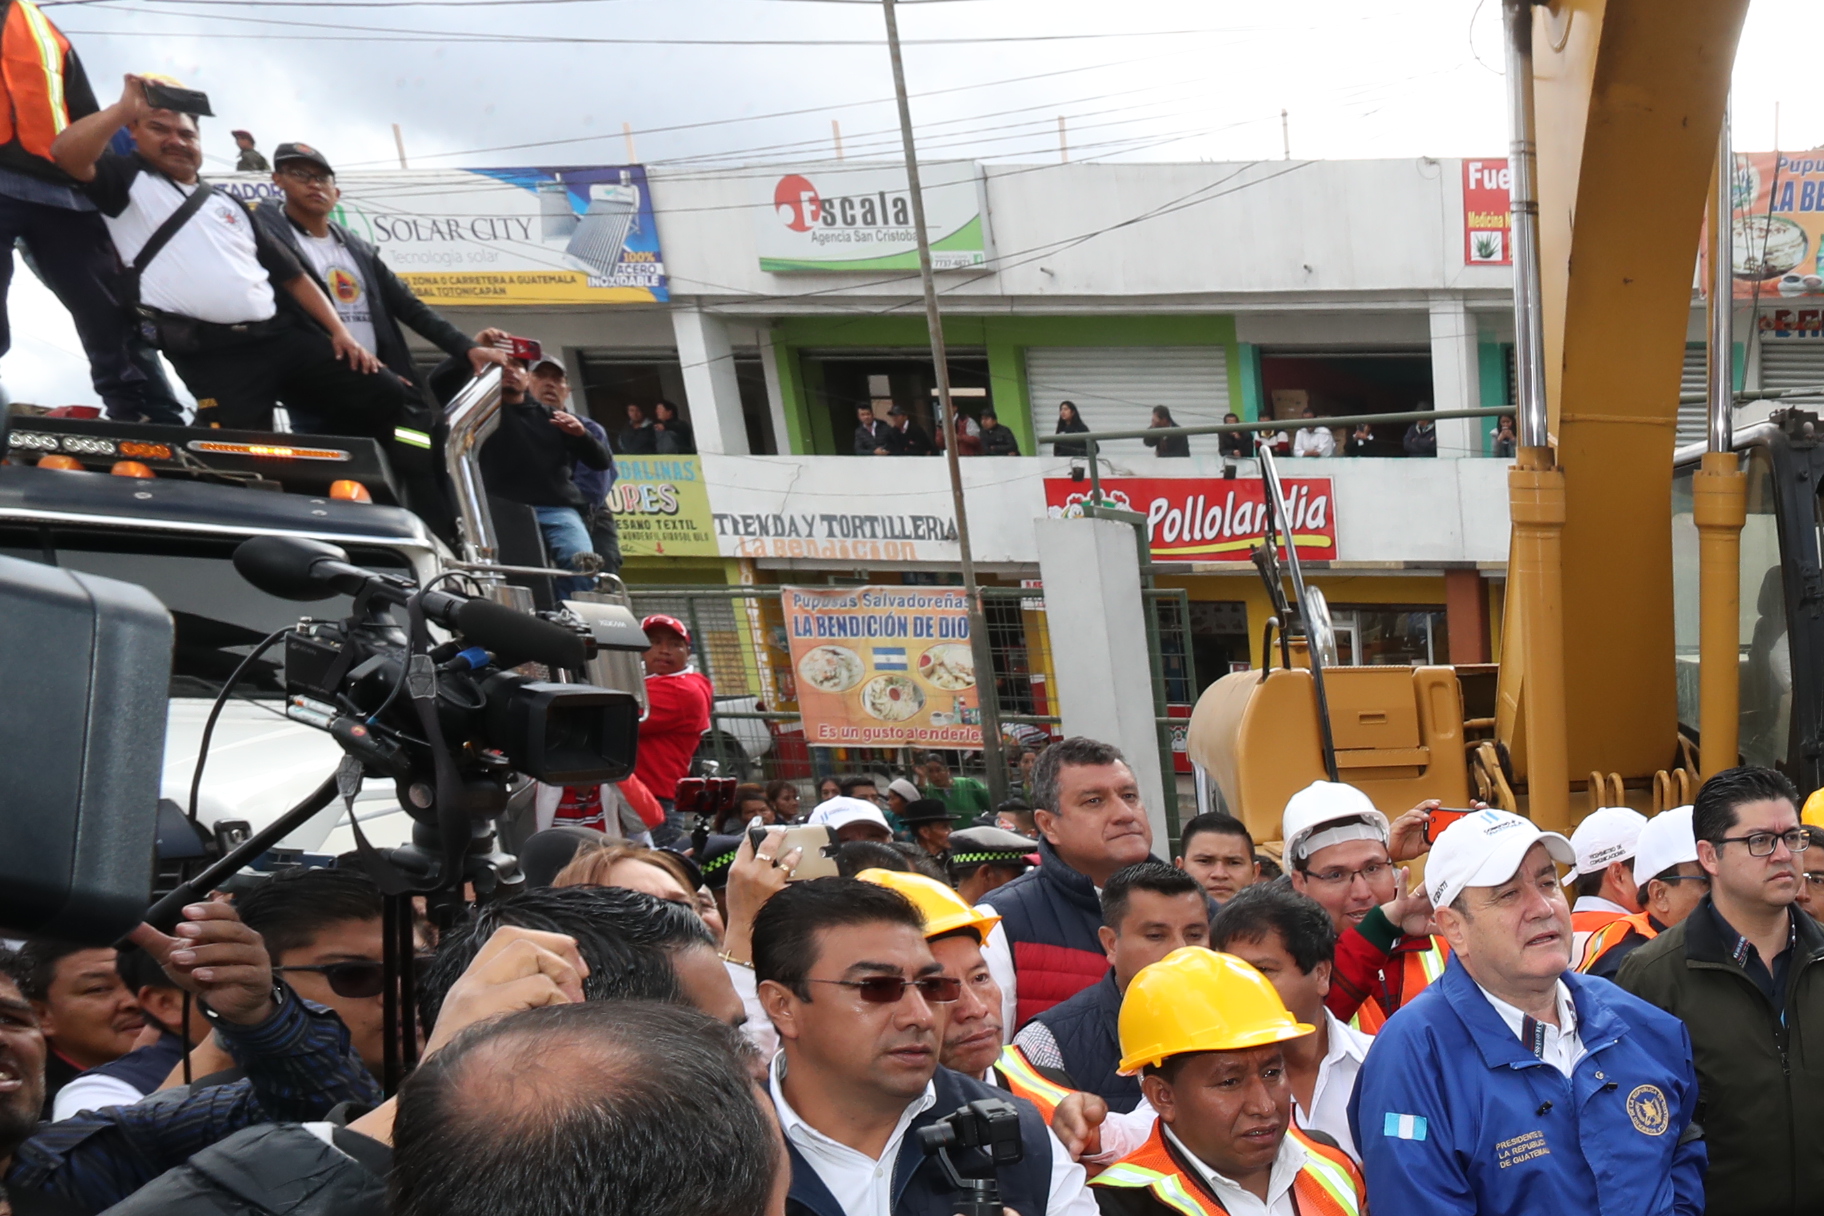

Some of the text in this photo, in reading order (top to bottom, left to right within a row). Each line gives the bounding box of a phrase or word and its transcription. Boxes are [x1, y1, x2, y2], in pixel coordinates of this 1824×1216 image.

[1468, 162, 1510, 190] Fue
[213, 183, 285, 199] TADOR
[1770, 183, 1795, 213] LA
[800, 181, 909, 227] Escala
[1468, 211, 1503, 228] Medicina
[373, 215, 532, 242] SOLAR CITY
[811, 229, 919, 246] Agencia San Cristoba
[466, 249, 500, 263] solar
[624, 252, 656, 262] 100%
[617, 264, 656, 274] ACERO
[413, 276, 437, 285] ZONA
[450, 274, 506, 285] CARRETERA
[517, 275, 577, 284] GUATEMALA
[587, 275, 660, 287] INOXIDABLE
[1149, 485, 1327, 543] Pollolandia
[615, 520, 697, 530] ESANO TEXTIL
[714, 514, 798, 538] TIENDA
[799, 515, 816, 537] Y
[862, 592, 969, 609] Salvadoreñas
[793, 611, 970, 639] LA BENDICIÓN DE DIO
[819, 724, 838, 738] Es
[841, 728, 859, 739] un
[863, 725, 903, 743] gusto
[1496, 1131, 1538, 1151] PRESIDENTE
[1499, 1150, 1511, 1159] LA
[1500, 1159, 1512, 1169] DE
